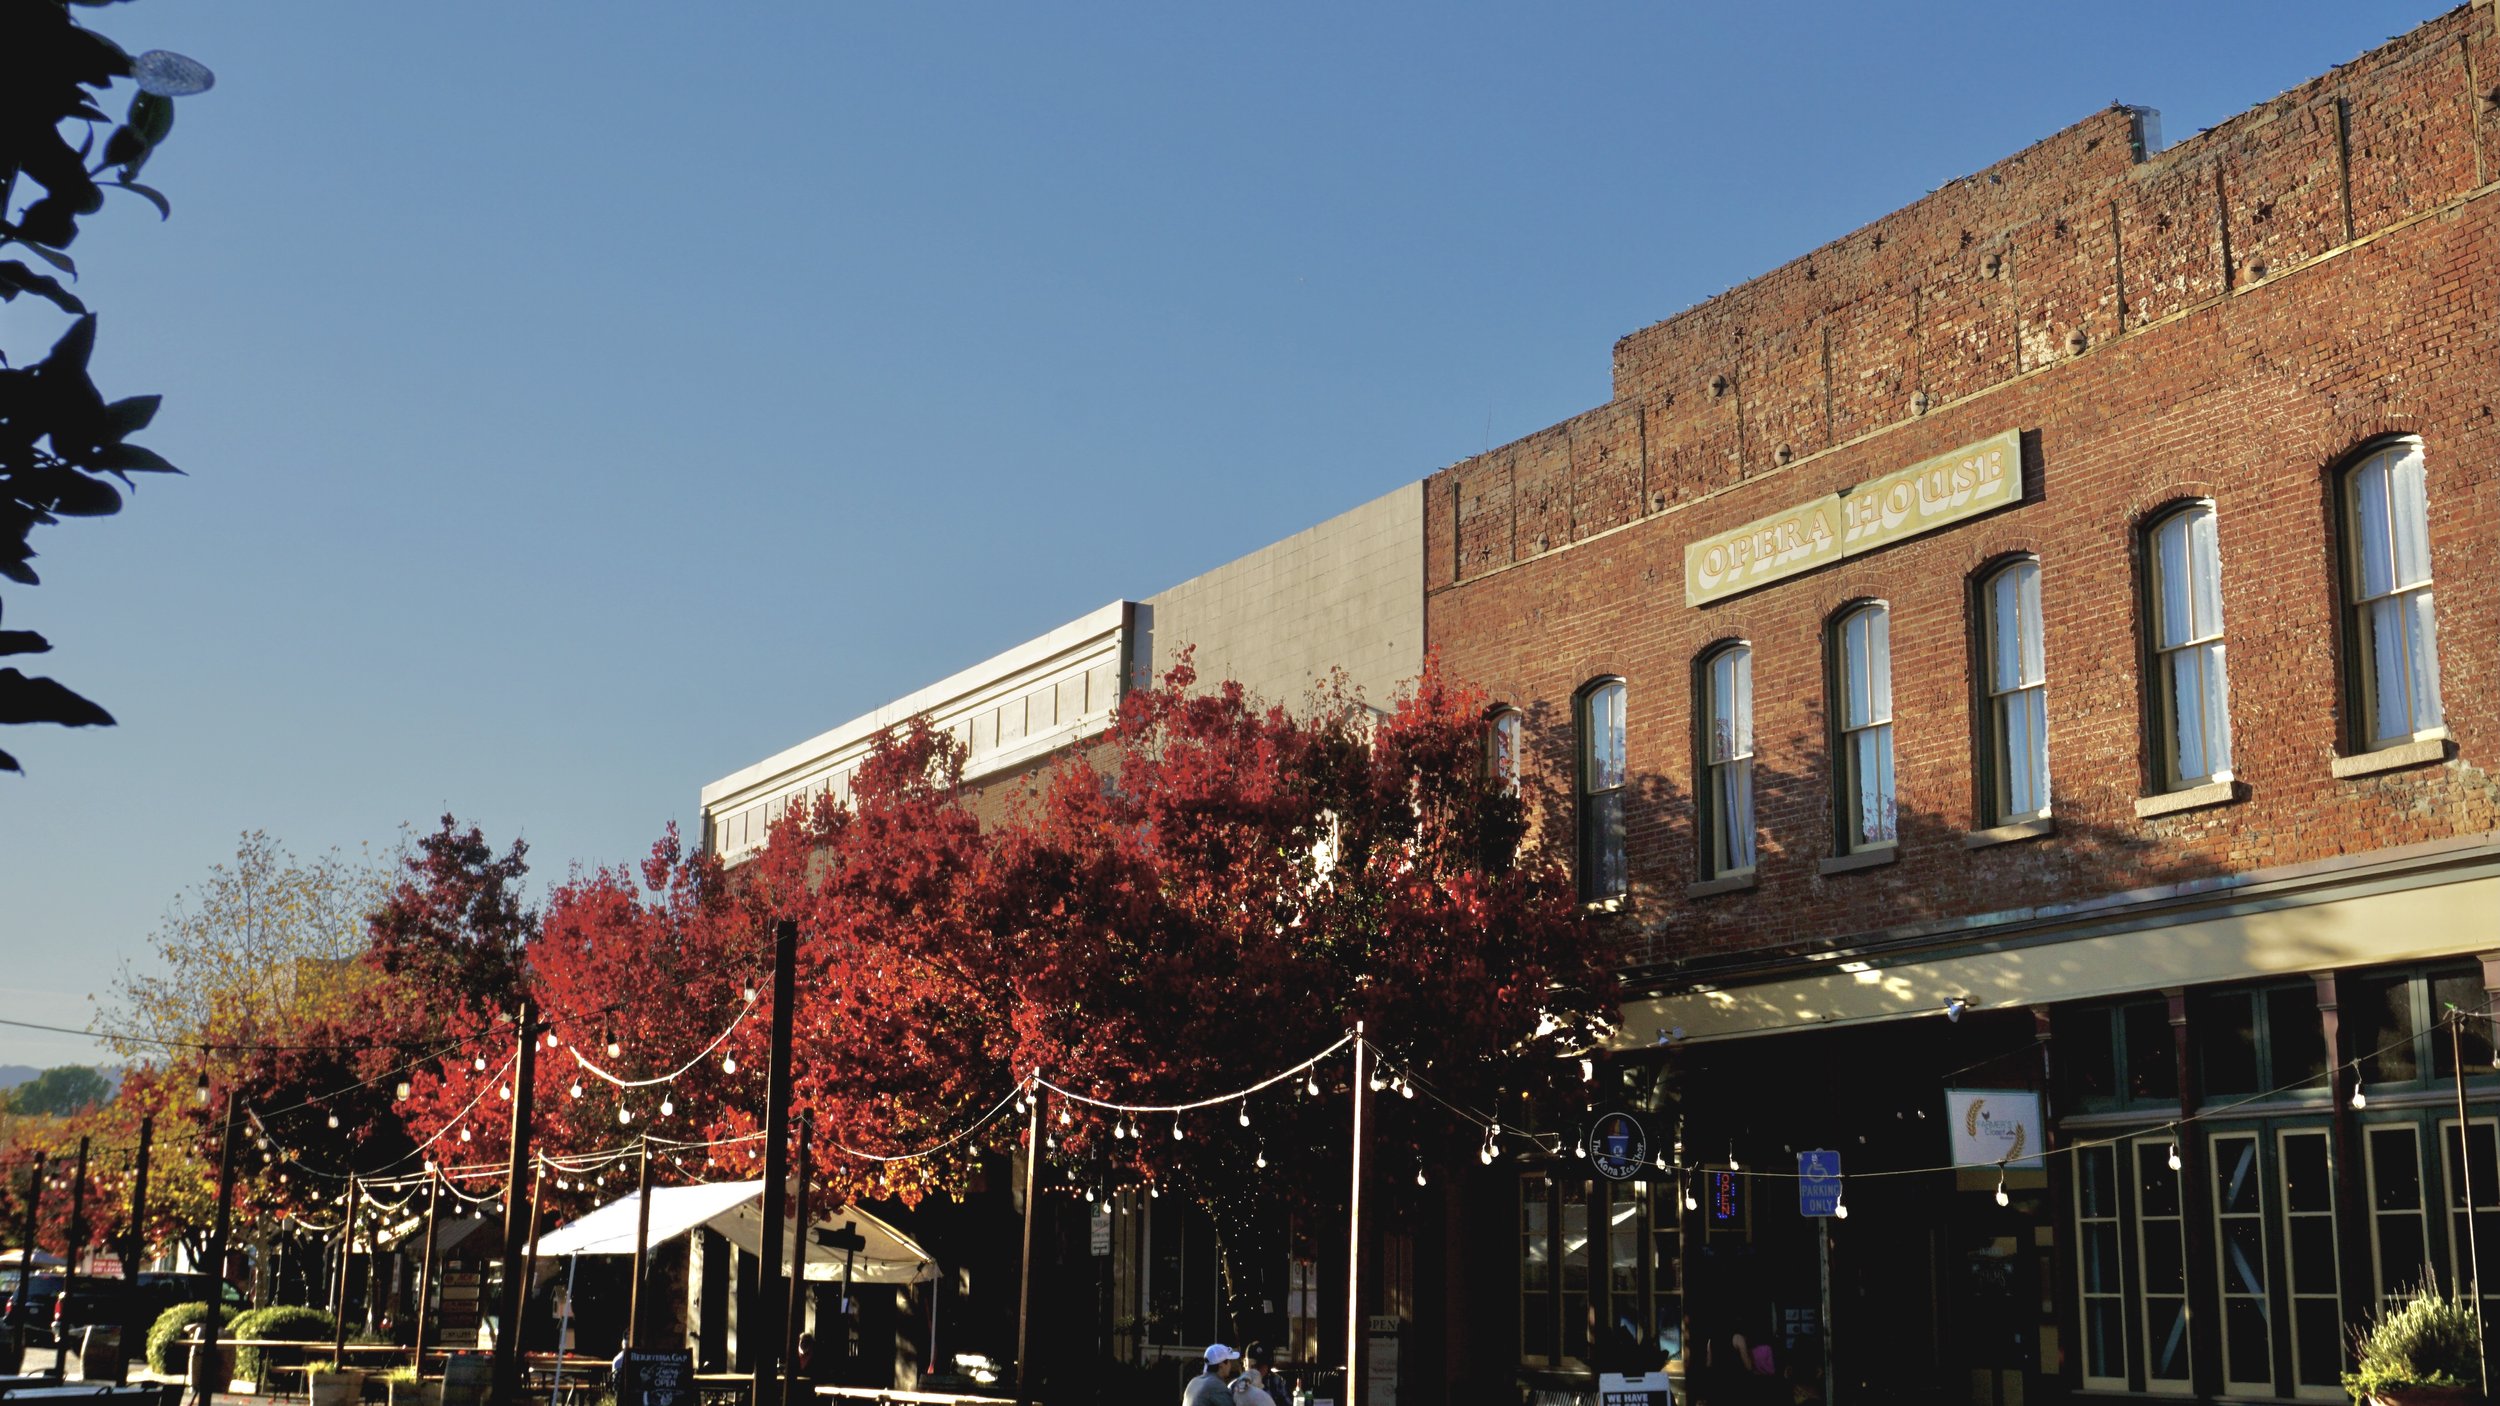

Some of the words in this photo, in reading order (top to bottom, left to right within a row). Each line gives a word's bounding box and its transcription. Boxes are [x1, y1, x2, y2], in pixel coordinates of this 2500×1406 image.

[1701, 508, 1834, 580] OPERA
[1848, 448, 2006, 530] HOUSE
[1597, 1156, 1618, 1176] Kona
[1620, 1164, 1635, 1176] Ice
[1632, 1142, 1644, 1166] Shop
[1721, 1174, 1730, 1215] OPEN
[1802, 1184, 1840, 1197] PARKING
[1093, 1205, 1100, 1217] 2
[1809, 1199, 1832, 1211] ONLY
[1607, 1394, 1621, 1403] WE
[1623, 1393, 1649, 1402] HAVE
